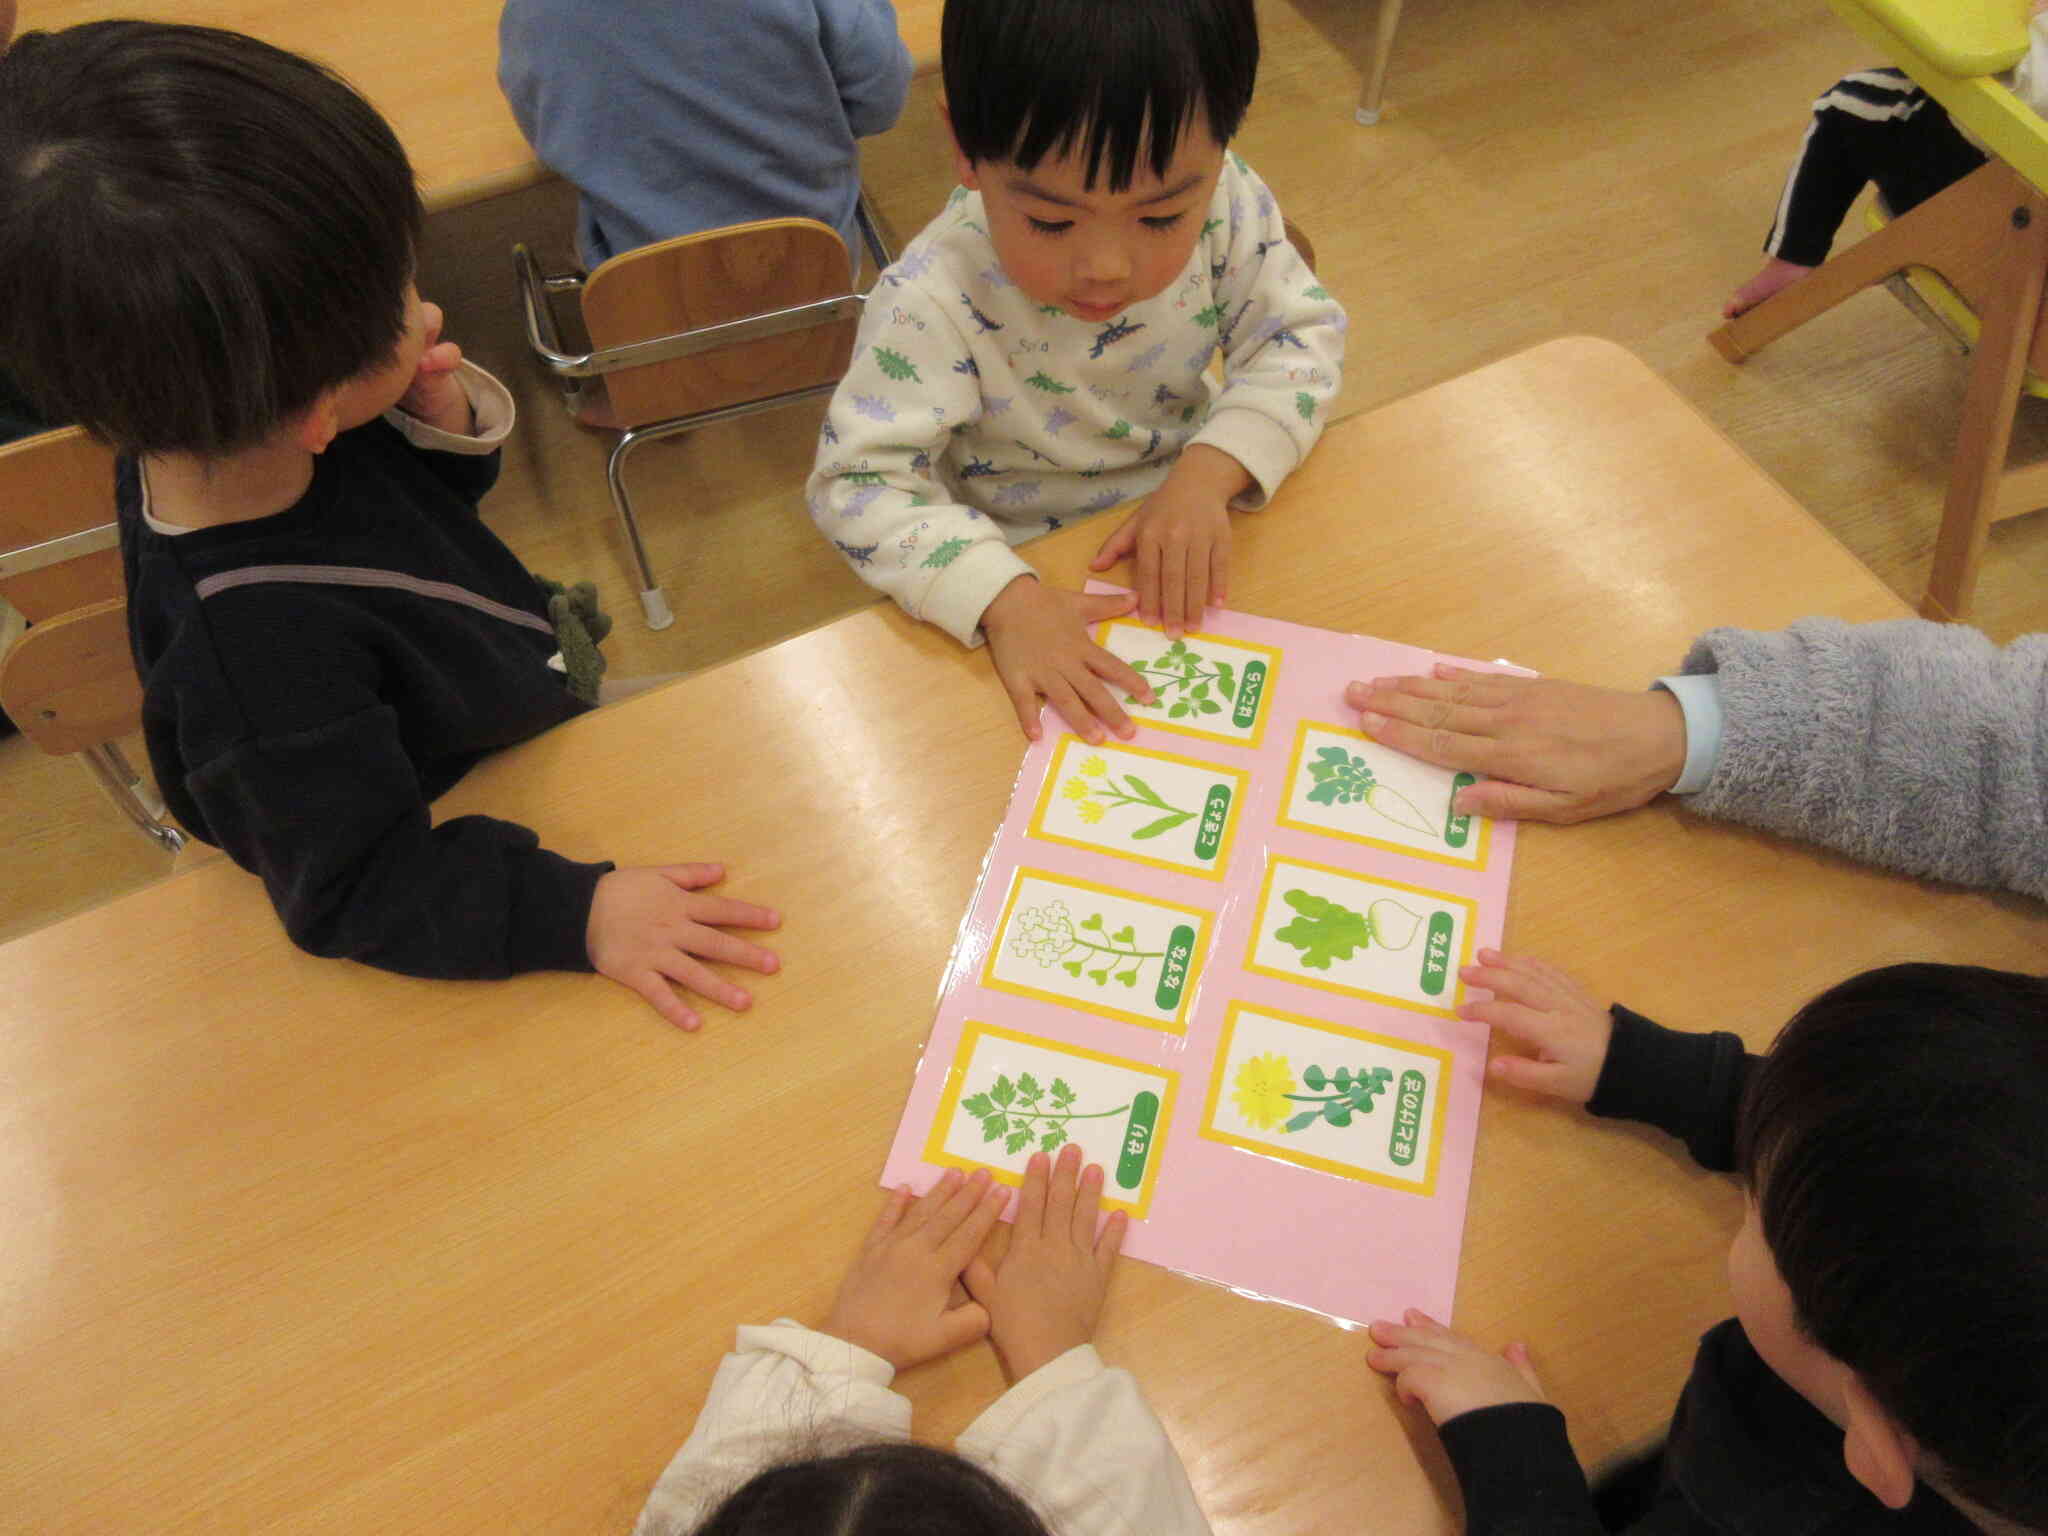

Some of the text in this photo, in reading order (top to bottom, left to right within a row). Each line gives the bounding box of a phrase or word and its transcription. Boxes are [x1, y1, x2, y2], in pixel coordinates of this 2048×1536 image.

[1237, 670, 1262, 718] はこべら
[1201, 797, 1225, 846] ごぎょう
[1163, 946, 1187, 989] なずな
[1427, 931, 1447, 974] すずな
[1127, 1123, 1148, 1156] せり
[1395, 1077, 1422, 1159] ほとけのざ
